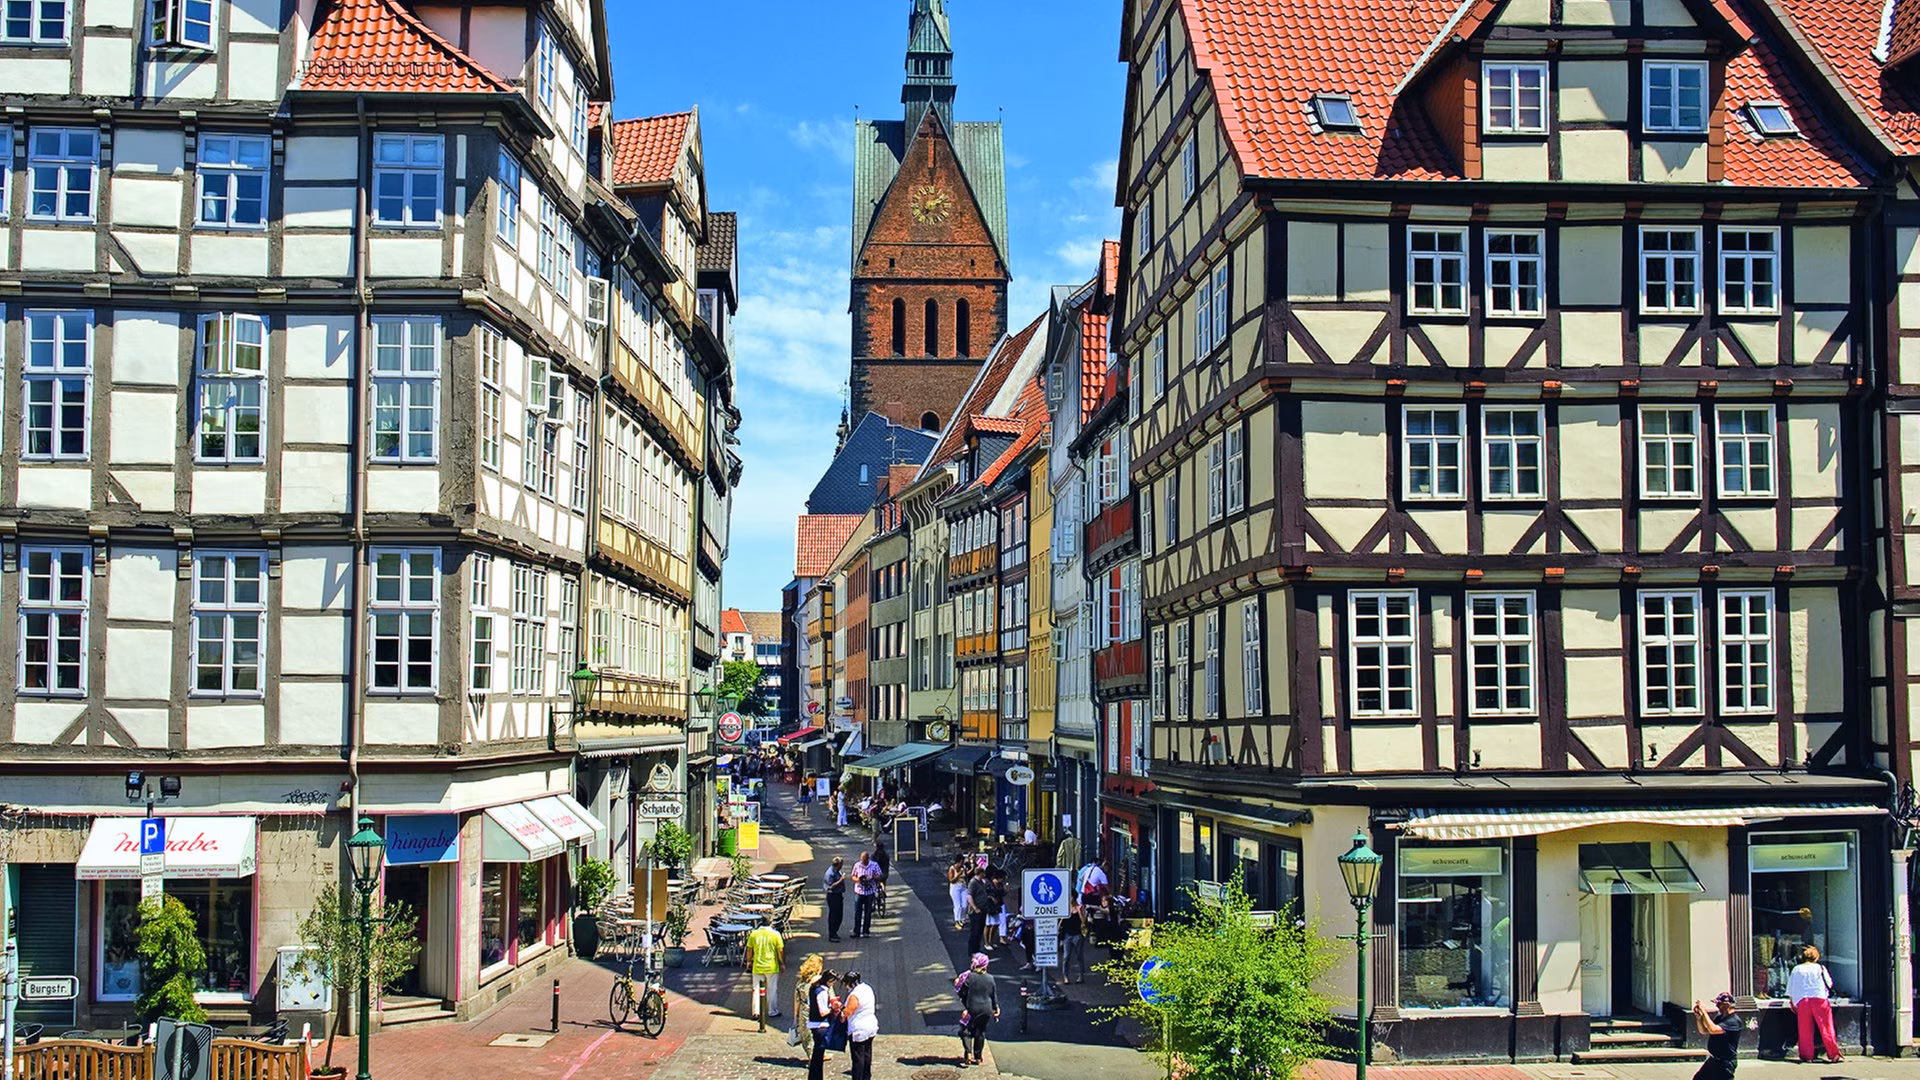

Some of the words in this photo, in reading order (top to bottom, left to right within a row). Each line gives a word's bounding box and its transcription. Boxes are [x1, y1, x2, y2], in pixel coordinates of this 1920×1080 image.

[114, 832, 218, 852] hiabe.
[144, 823, 158, 850] P
[1034, 906, 1058, 915] ZONE
[30, 984, 67, 995] Burgstr.
